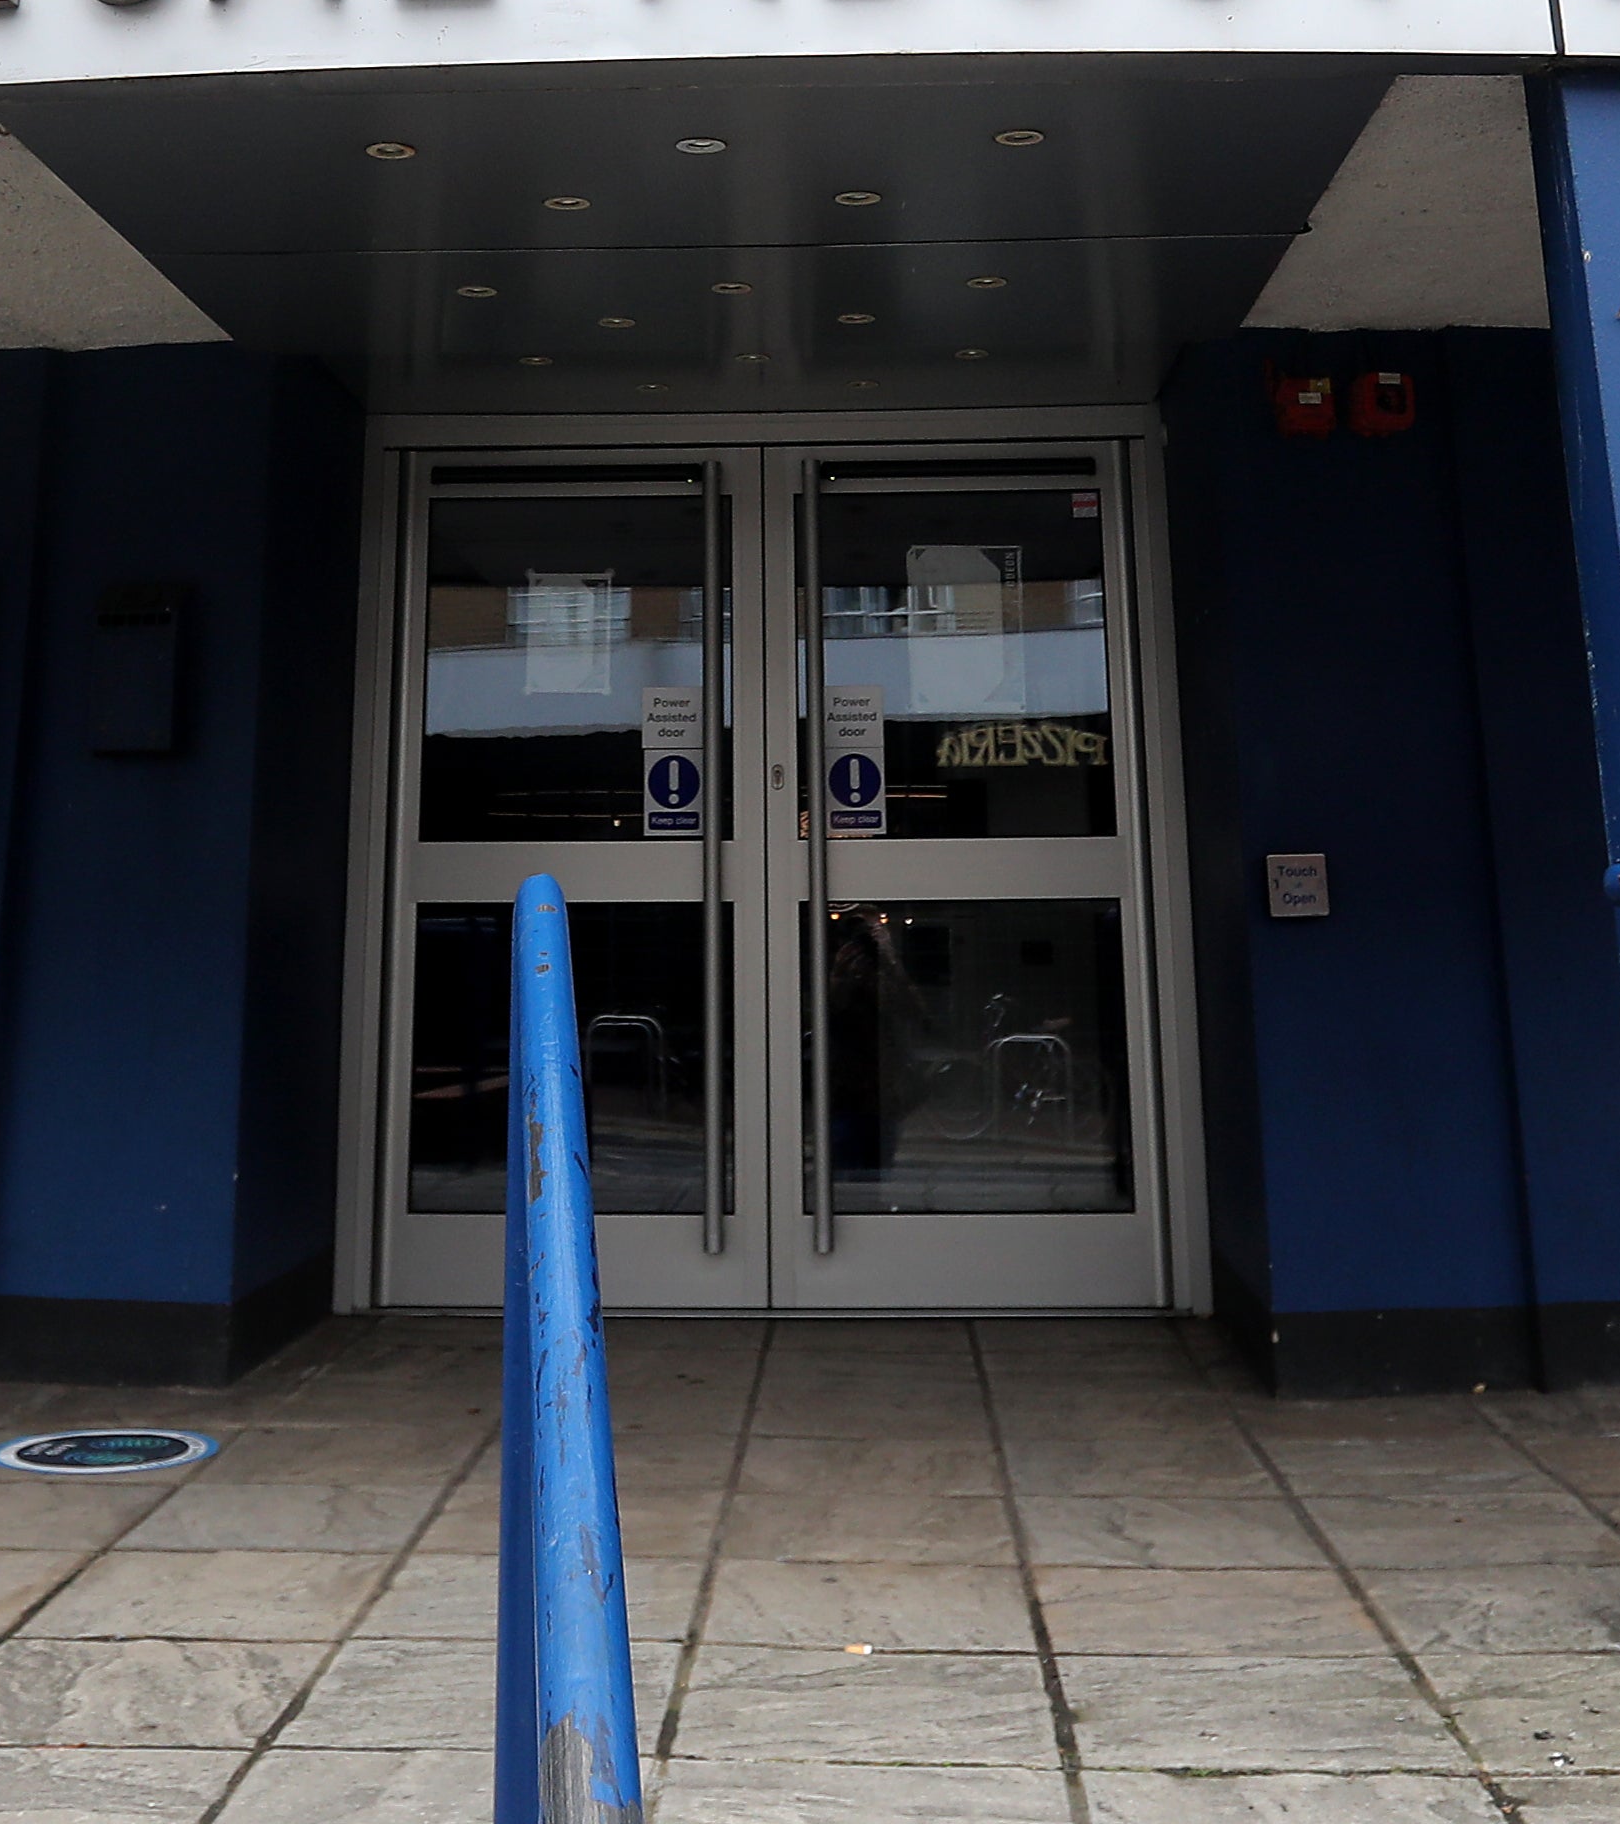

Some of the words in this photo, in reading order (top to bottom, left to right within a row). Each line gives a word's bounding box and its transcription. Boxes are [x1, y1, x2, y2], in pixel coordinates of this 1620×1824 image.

[653, 697, 691, 708] Power
[832, 696, 871, 707] Power
[646, 712, 697, 723] Assisted
[826, 711, 878, 722] Assisted
[657, 727, 686, 738] door
[838, 726, 867, 737] door
[650, 815, 672, 826] Keep
[675, 815, 697, 825] clear
[832, 814, 854, 825] Keep
[857, 814, 879, 824] clear
[1277, 865, 1317, 877] Touch
[1282, 892, 1317, 907] Open
